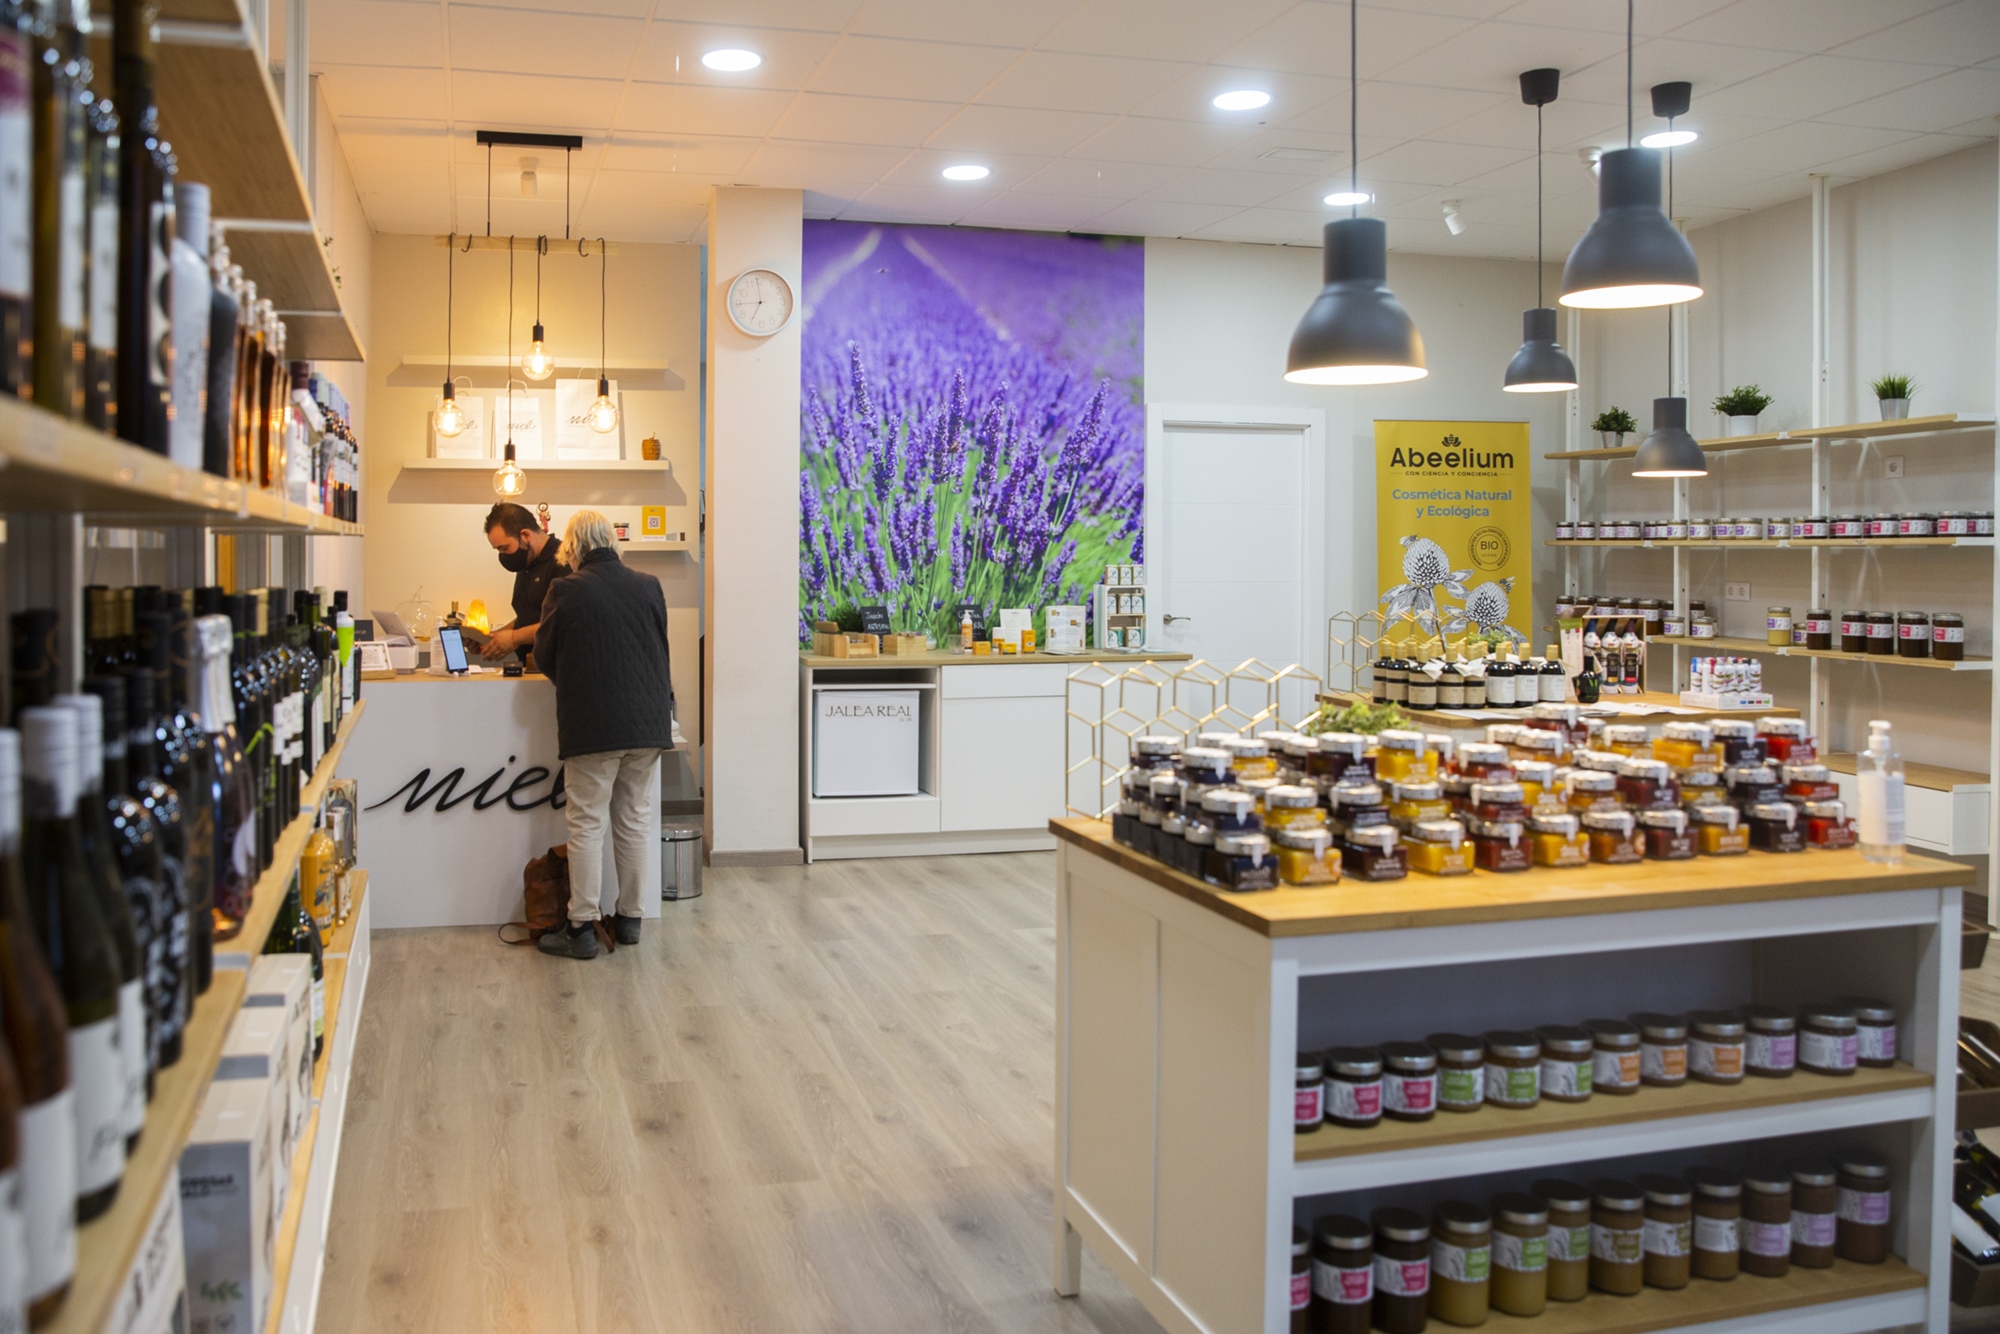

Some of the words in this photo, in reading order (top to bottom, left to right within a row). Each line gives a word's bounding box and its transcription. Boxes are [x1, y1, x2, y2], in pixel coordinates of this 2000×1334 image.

[1390, 447, 1514, 469] Abeelium
[1392, 488, 1461, 501] Cosmética
[1465, 489, 1513, 501] Natural
[1416, 507, 1424, 519] y
[1427, 505, 1490, 519] Ecológica
[1480, 540, 1499, 551] BIO
[825, 705, 874, 717] JALEA
[876, 705, 912, 717] REAL
